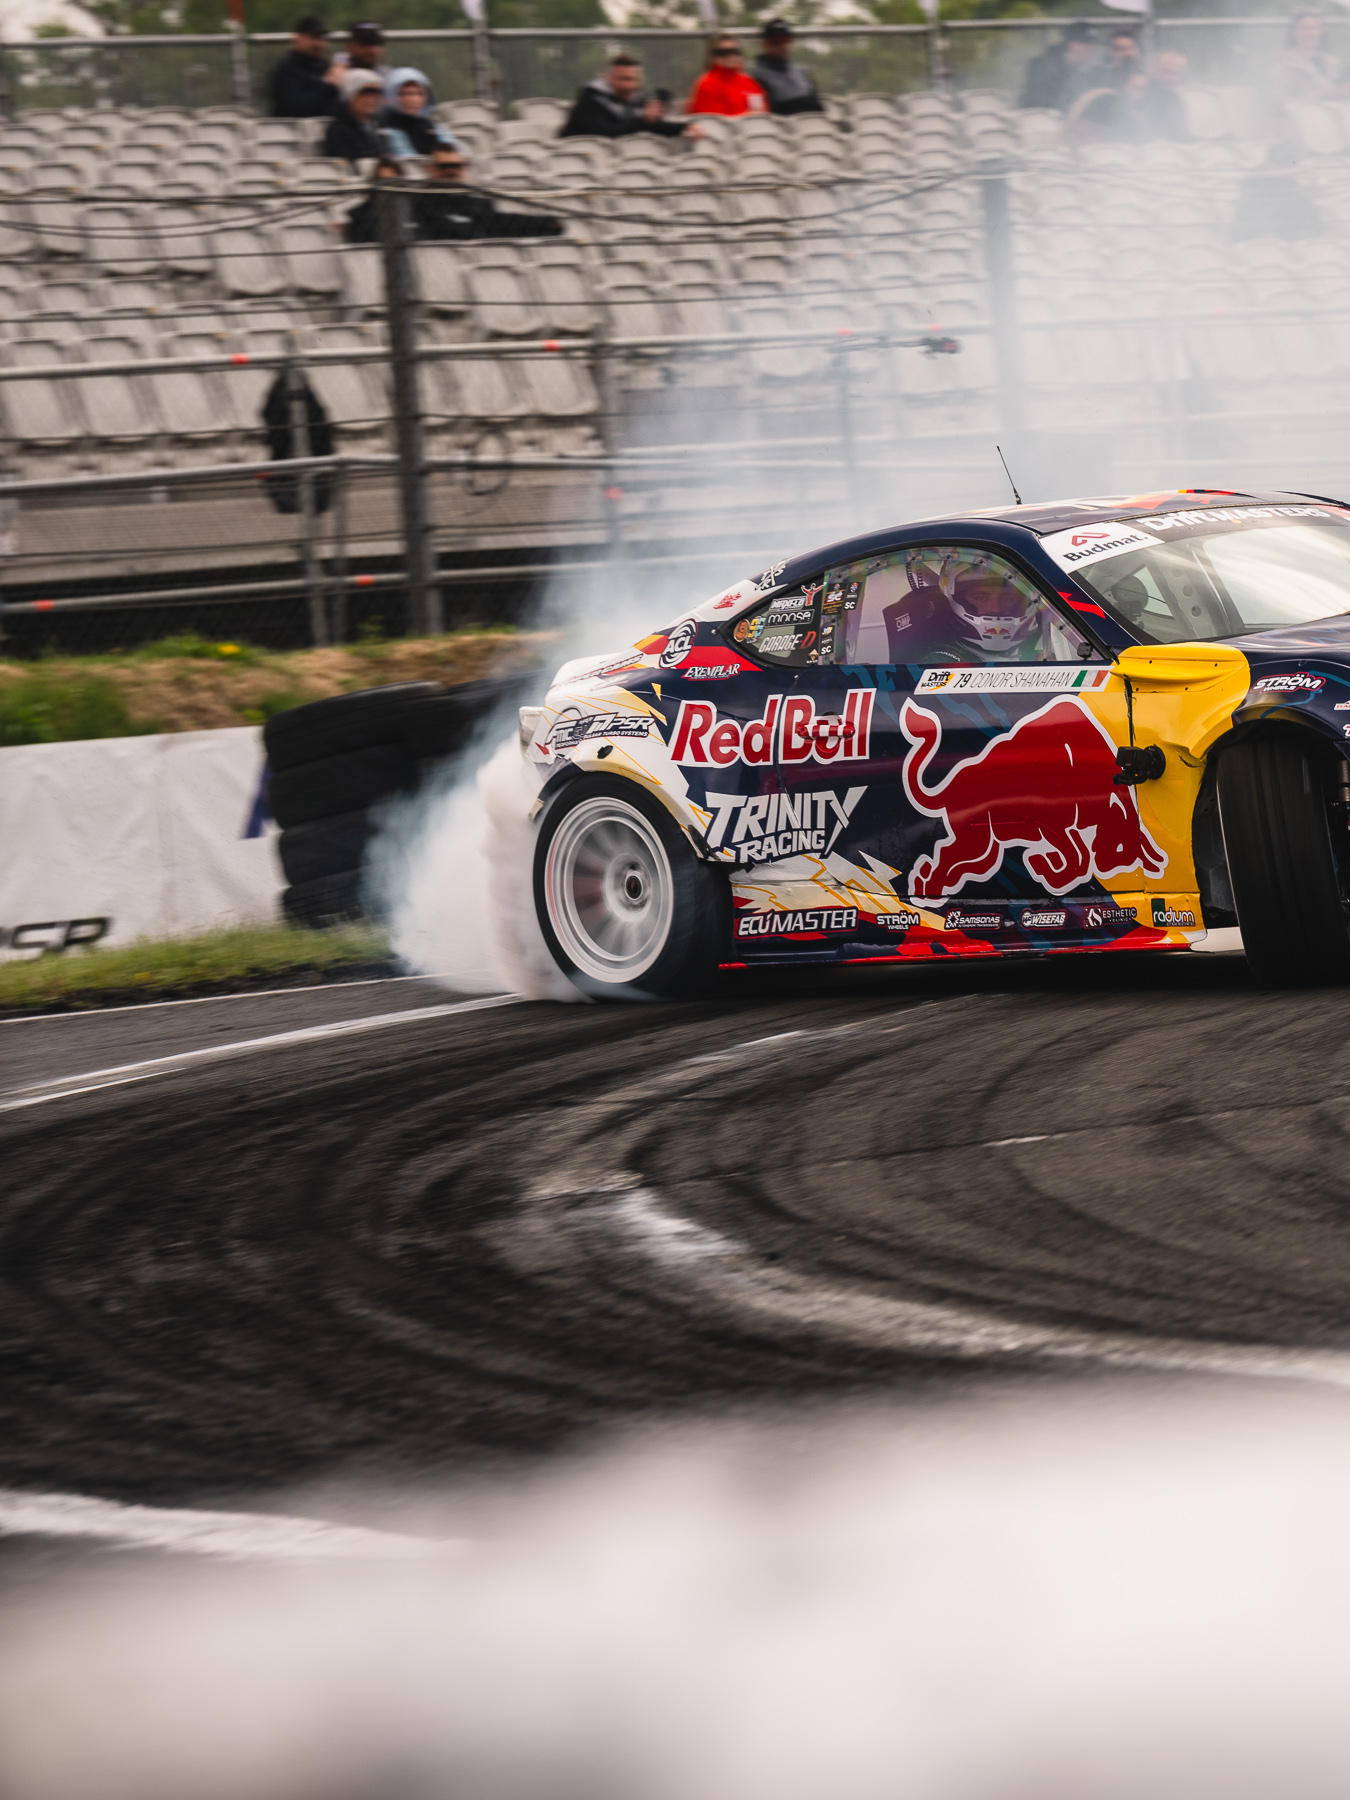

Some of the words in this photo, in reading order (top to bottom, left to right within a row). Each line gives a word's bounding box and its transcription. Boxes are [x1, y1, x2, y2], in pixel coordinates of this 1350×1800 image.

[1136, 510, 1213, 531] Drift
[1211, 507, 1331, 522] MASTERS
[666, 635, 693, 653] ACL
[683, 663, 741, 678] EXEMPLAR
[928, 671, 951, 682] Drift
[953, 673, 973, 688] 79
[970, 672, 1014, 688] CONOR
[1010, 671, 1075, 688] SHANAHAN
[1253, 673, 1323, 690] STRÖM
[606, 718, 655, 730] PSR
[705, 785, 868, 855] TRINITY
[735, 830, 826, 863] RACING
[877, 910, 919, 925] STRÖM
[959, 916, 1001, 924] SAMSONAS
[1032, 914, 1066, 924] WISEFAB
[1102, 908, 1137, 919] ESTHETIC
[1153, 906, 1195, 923] radium
